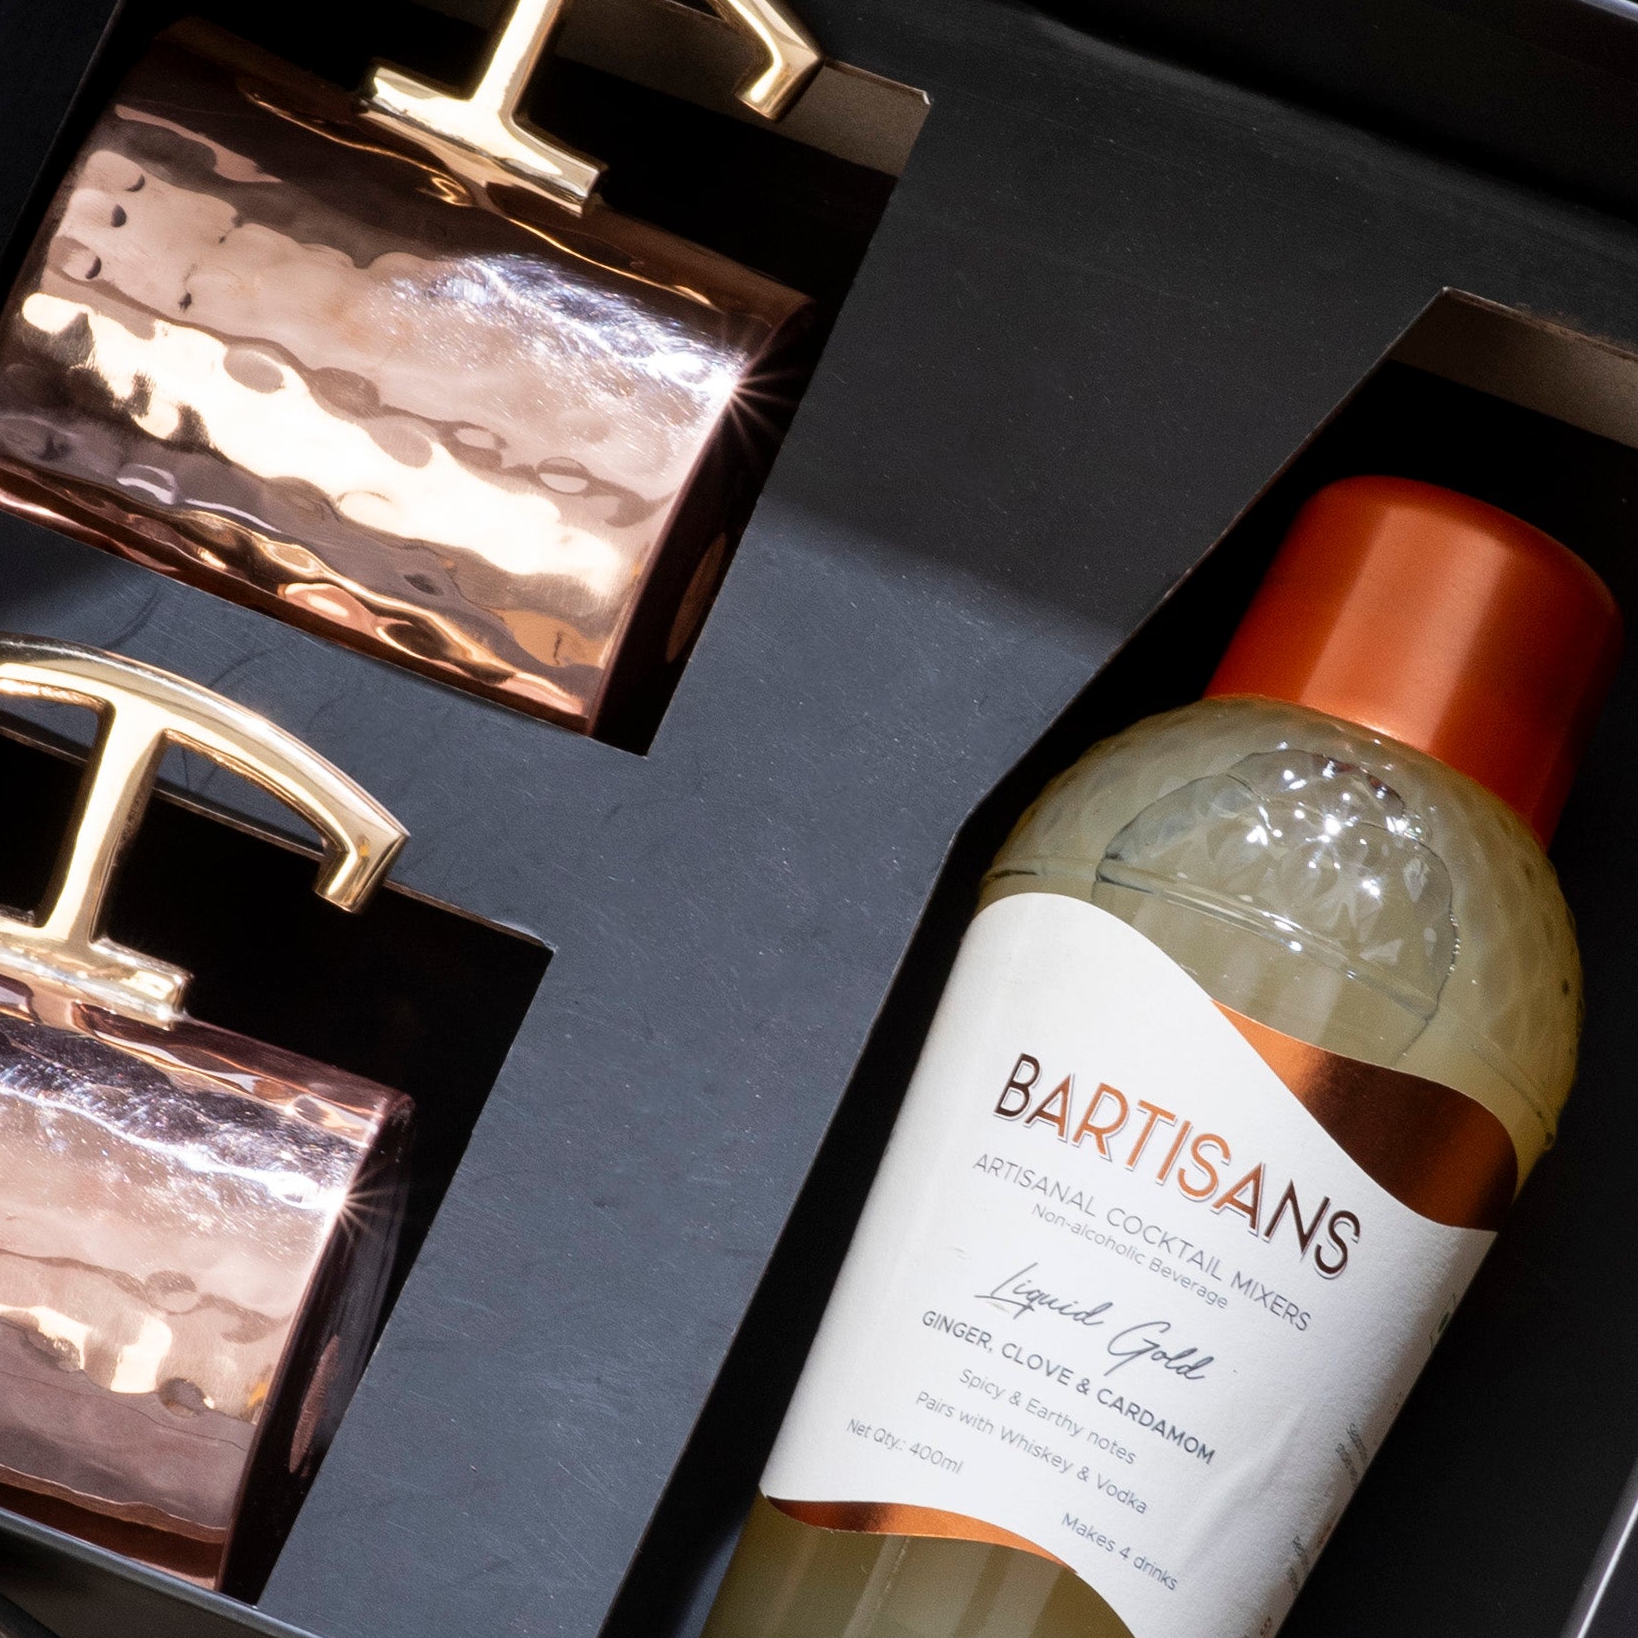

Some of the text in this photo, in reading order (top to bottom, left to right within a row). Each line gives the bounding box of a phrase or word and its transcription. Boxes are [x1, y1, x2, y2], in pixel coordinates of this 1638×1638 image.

[994, 1053, 1361, 1280] BARTISANS
[974, 1154, 1311, 1331] ARTISANAL COCKTAIL MIXERS
[1032, 1203, 1227, 1309] Non-alcoholic Beverage
[974, 1263, 1214, 1381] Liquid Gold
[846, 1417, 872, 1436] Net
[909, 1441, 963, 1475] 400ml
[922, 1310, 1215, 1464] GINGER, CLOVE & CARDAMOM
[959, 1369, 1136, 1465] Spicy & Earthy notes
[916, 1391, 1147, 1514] Pairs with Whiskey & Vodka
[1062, 1512, 1178, 1591] Makes 4 drinks
